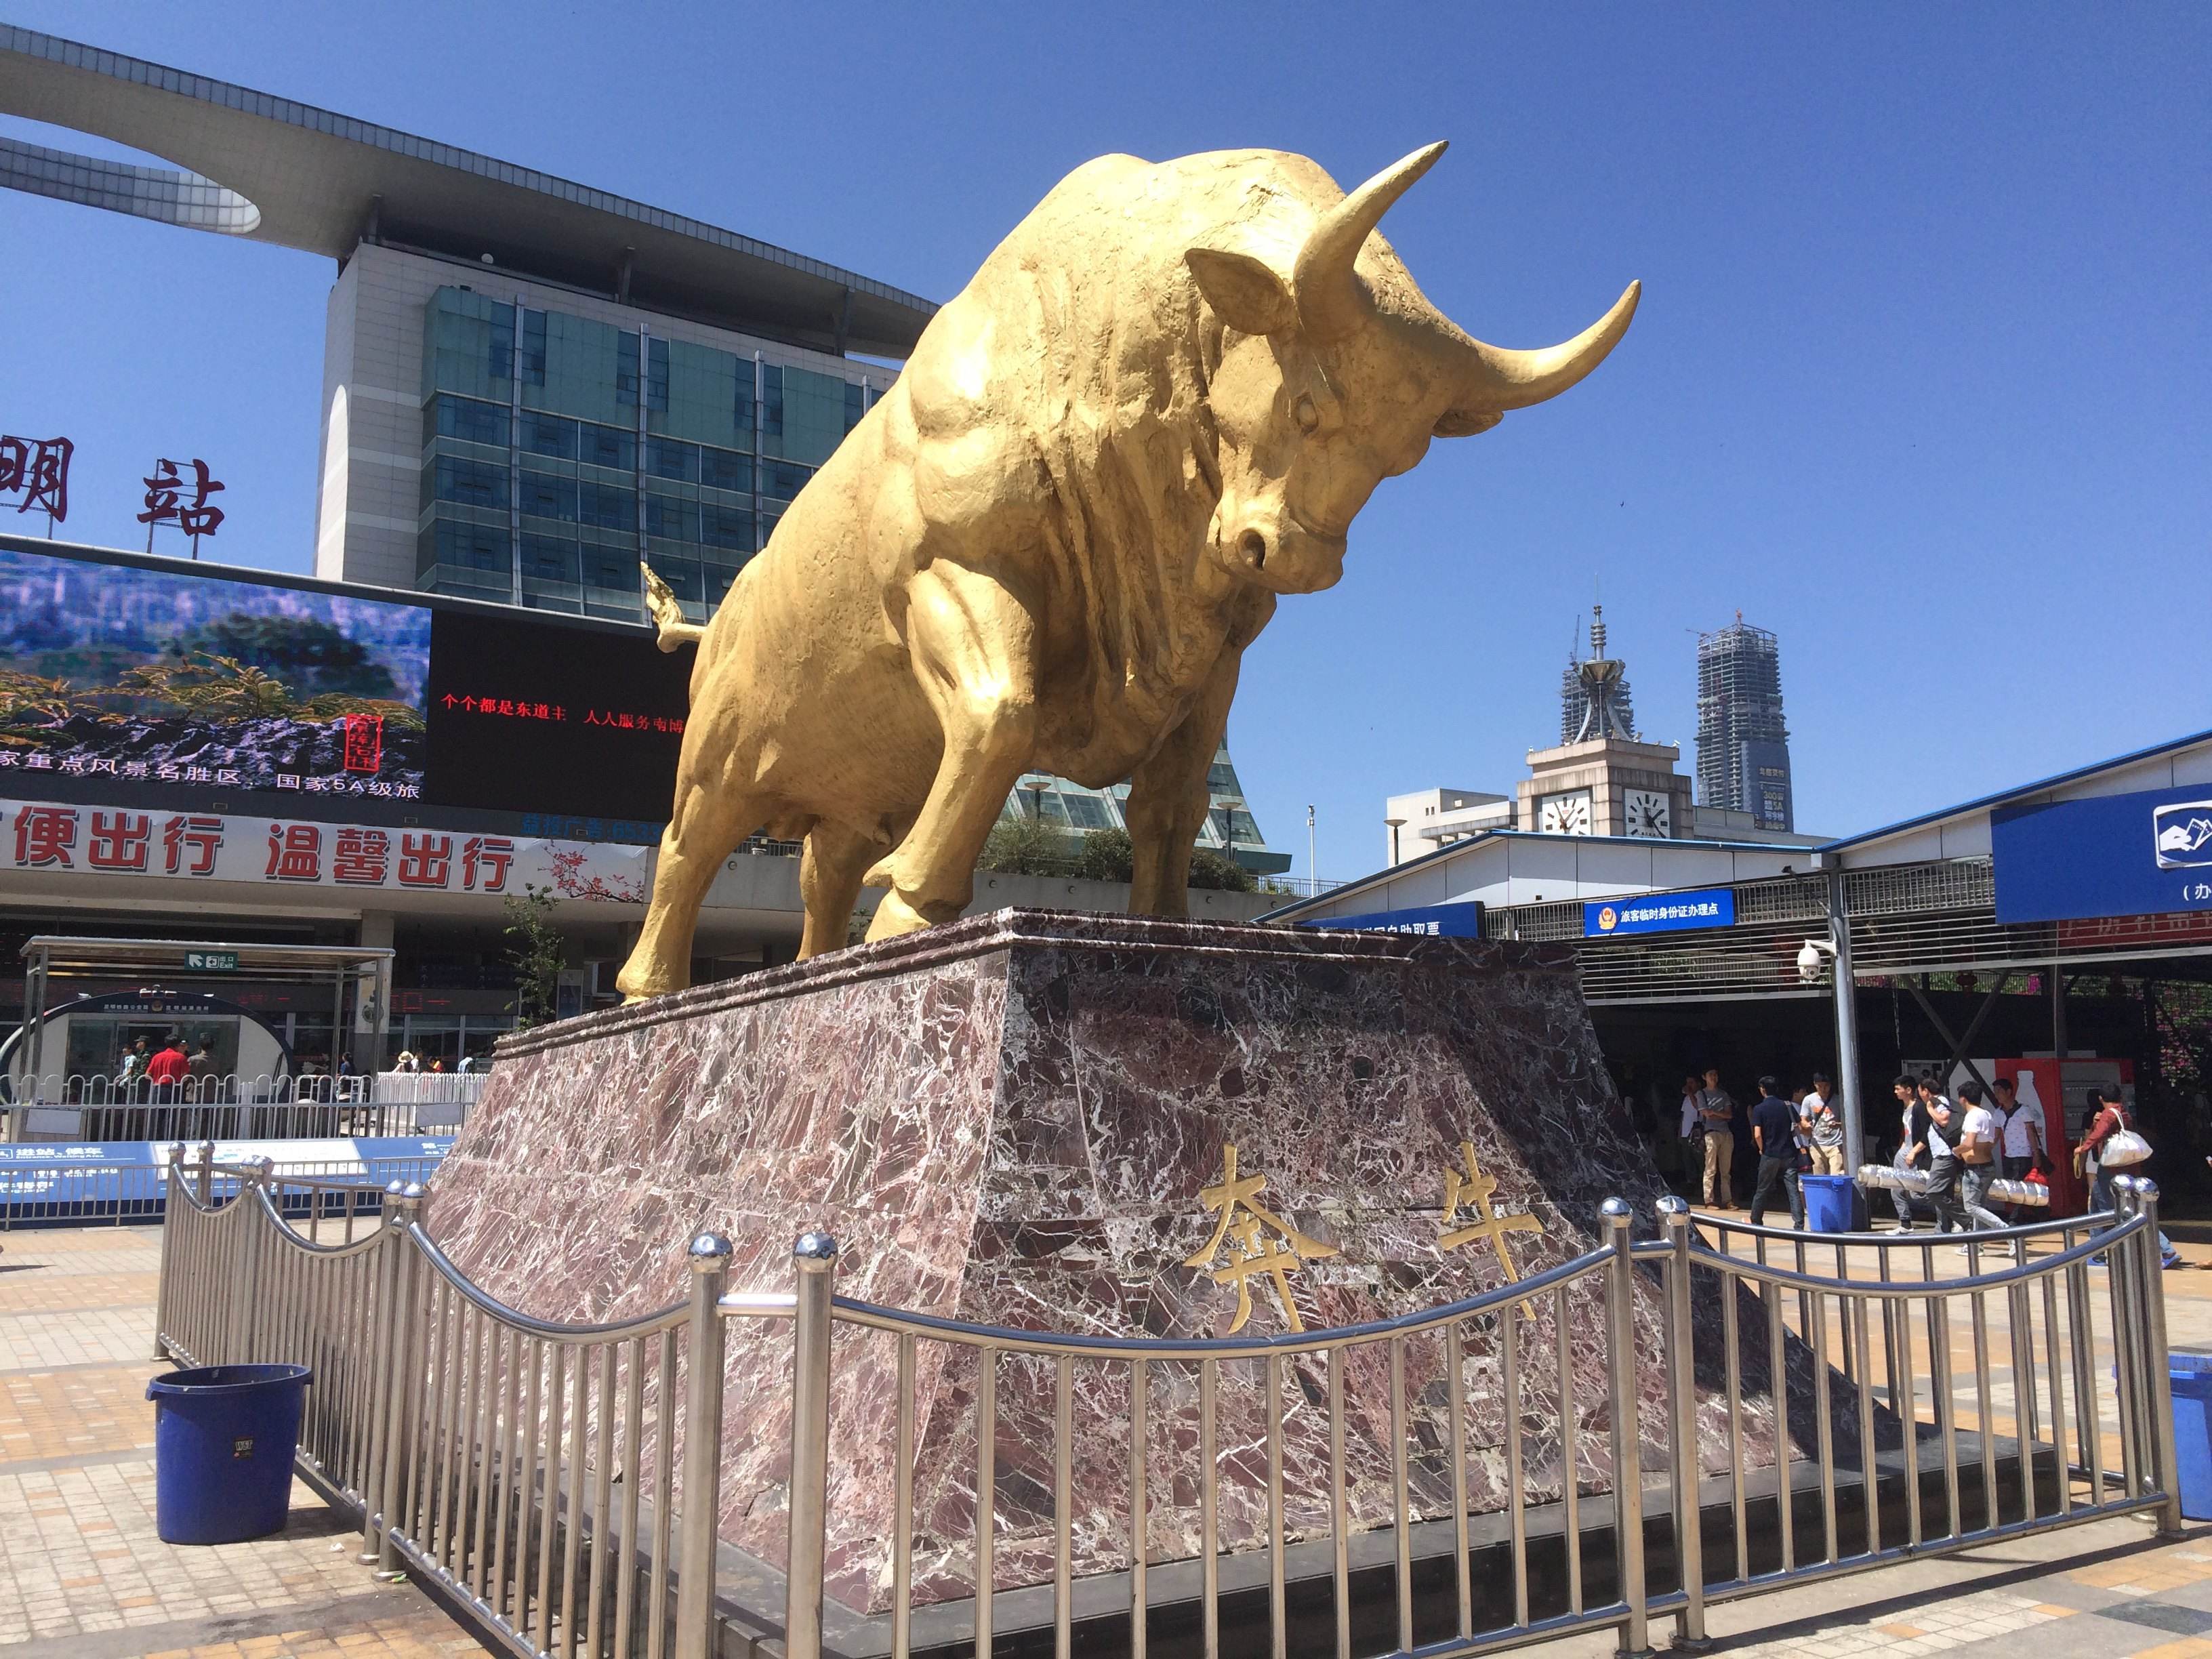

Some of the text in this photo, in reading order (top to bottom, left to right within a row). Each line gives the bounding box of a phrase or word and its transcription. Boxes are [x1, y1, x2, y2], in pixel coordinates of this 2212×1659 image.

[441, 693, 567, 720] 个个都是东道主
[276, 773, 421, 799] 国家5A级旅
[14, 806, 514, 893] 便出行 温馨出行
[1621, 903, 1719, 922] 旅客临时身份证办理点
